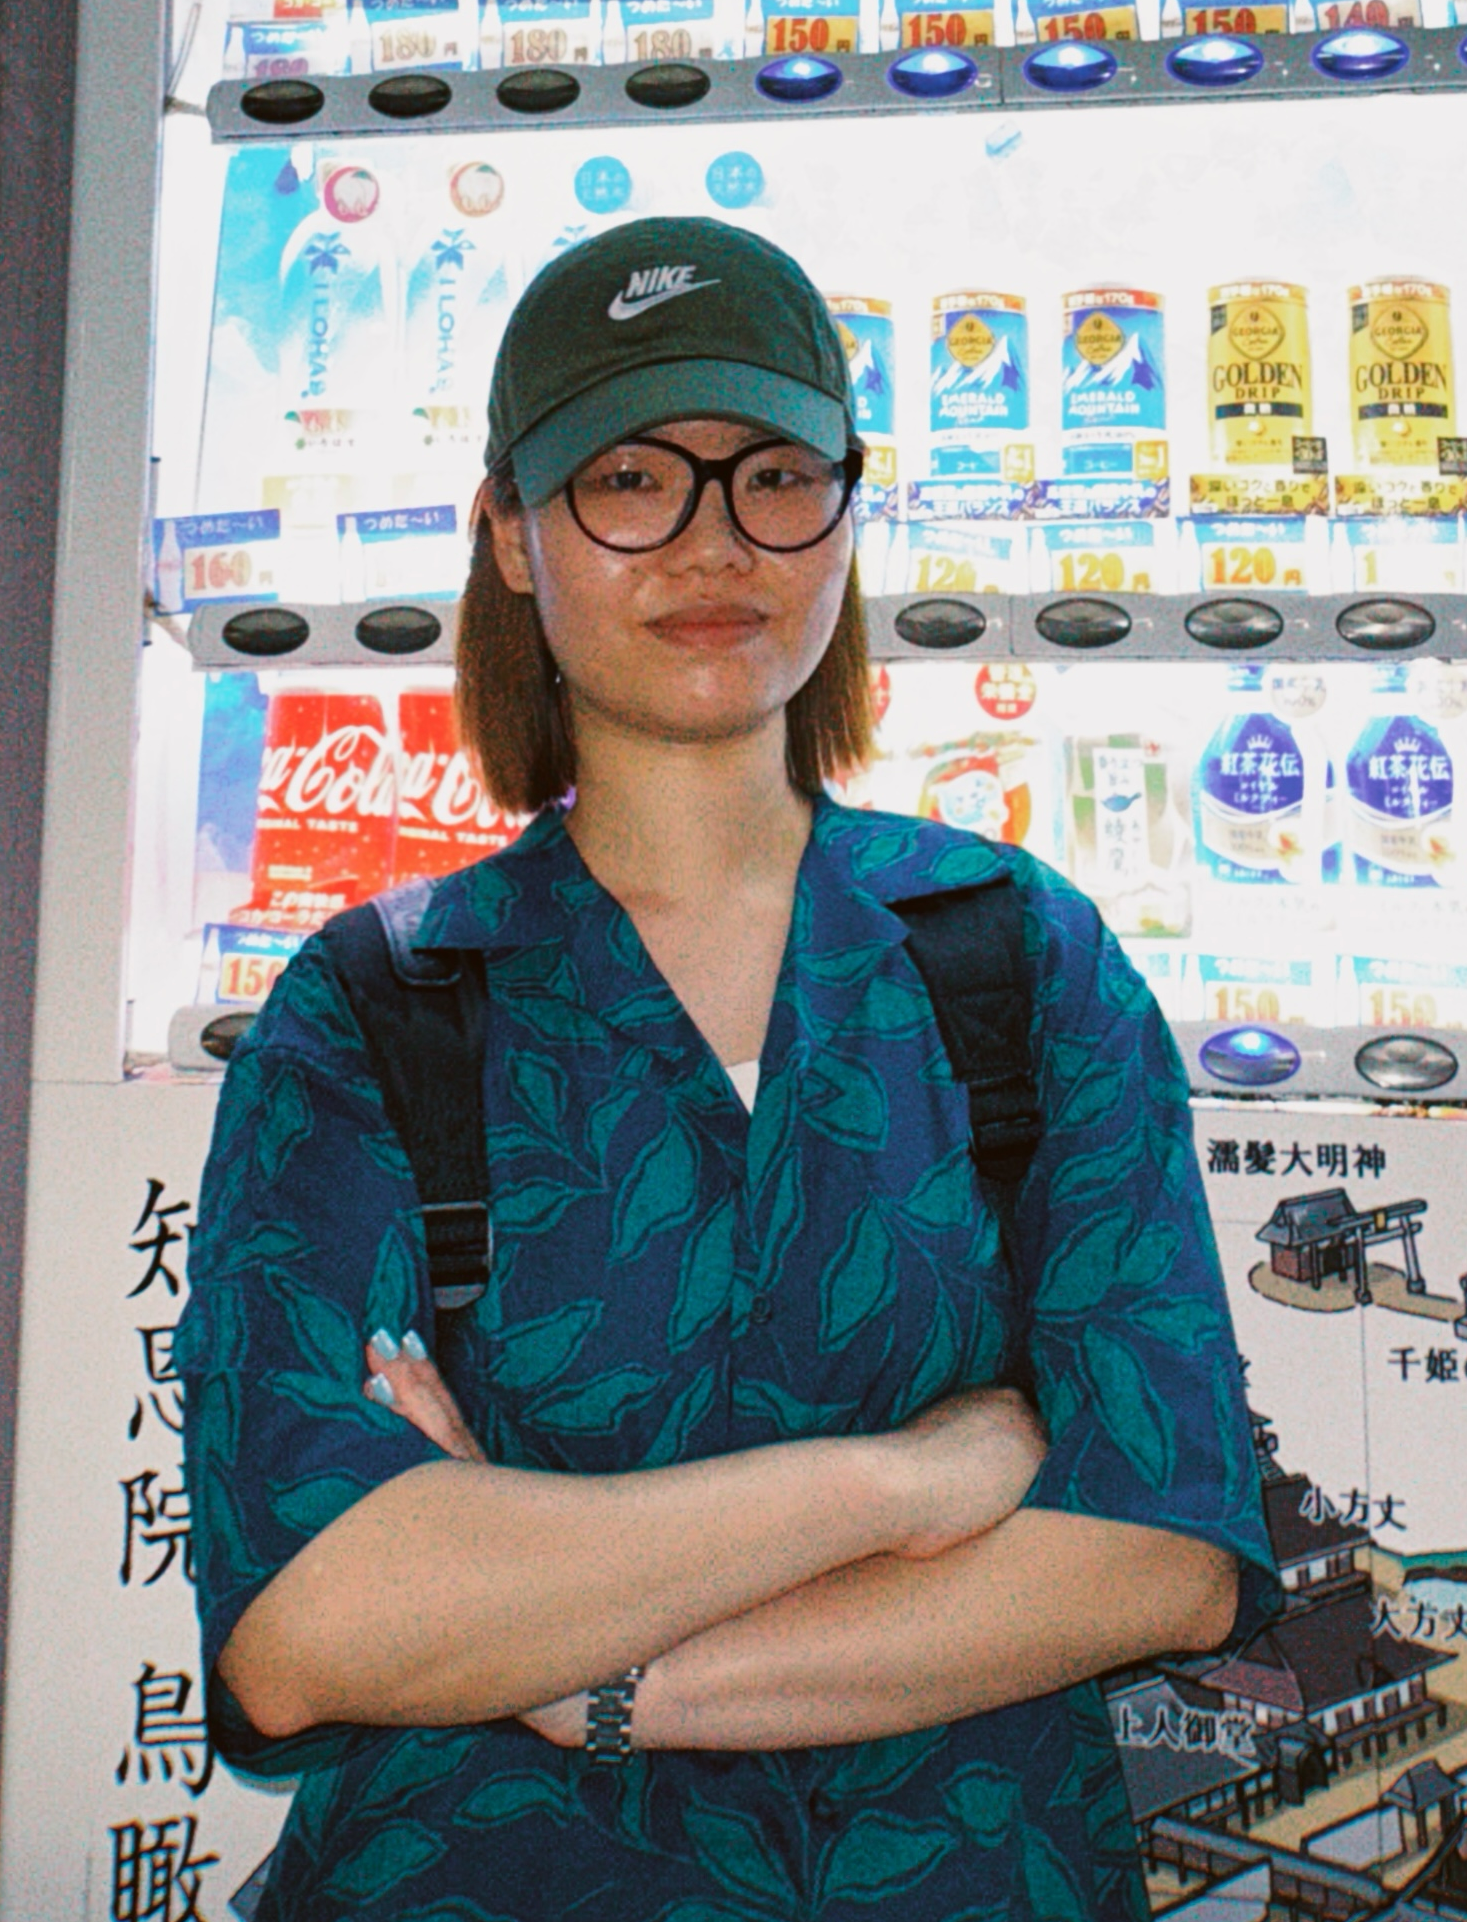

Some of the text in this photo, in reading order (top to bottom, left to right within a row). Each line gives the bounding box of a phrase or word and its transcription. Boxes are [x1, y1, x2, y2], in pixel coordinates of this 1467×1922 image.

[773, 18, 830, 52] 150
[908, 13, 967, 47] 150
[1044, 12, 1106, 40] 150
[1193, 8, 1257, 34] 150
[511, 28, 568, 63] 180
[625, 264, 697, 299] NIKE
[1212, 361, 1304, 393] GOLDEN
[1234, 387, 1281, 400] DRIP
[1354, 361, 1448, 393] GOLDEN
[1377, 387, 1426, 401] DRIP
[1059, 552, 1125, 591] 120
[1211, 546, 1276, 585] 120
[1219, 752, 1300, 777] 紅茶花伝
[1368, 755, 1450, 780] 紅茶花伝
[1214, 985, 1280, 1022] 150
[1369, 987, 1438, 1026] 150
[1387, 1346, 1467, 1385] 千姫
[1299, 1485, 1406, 1531] 小方丈
